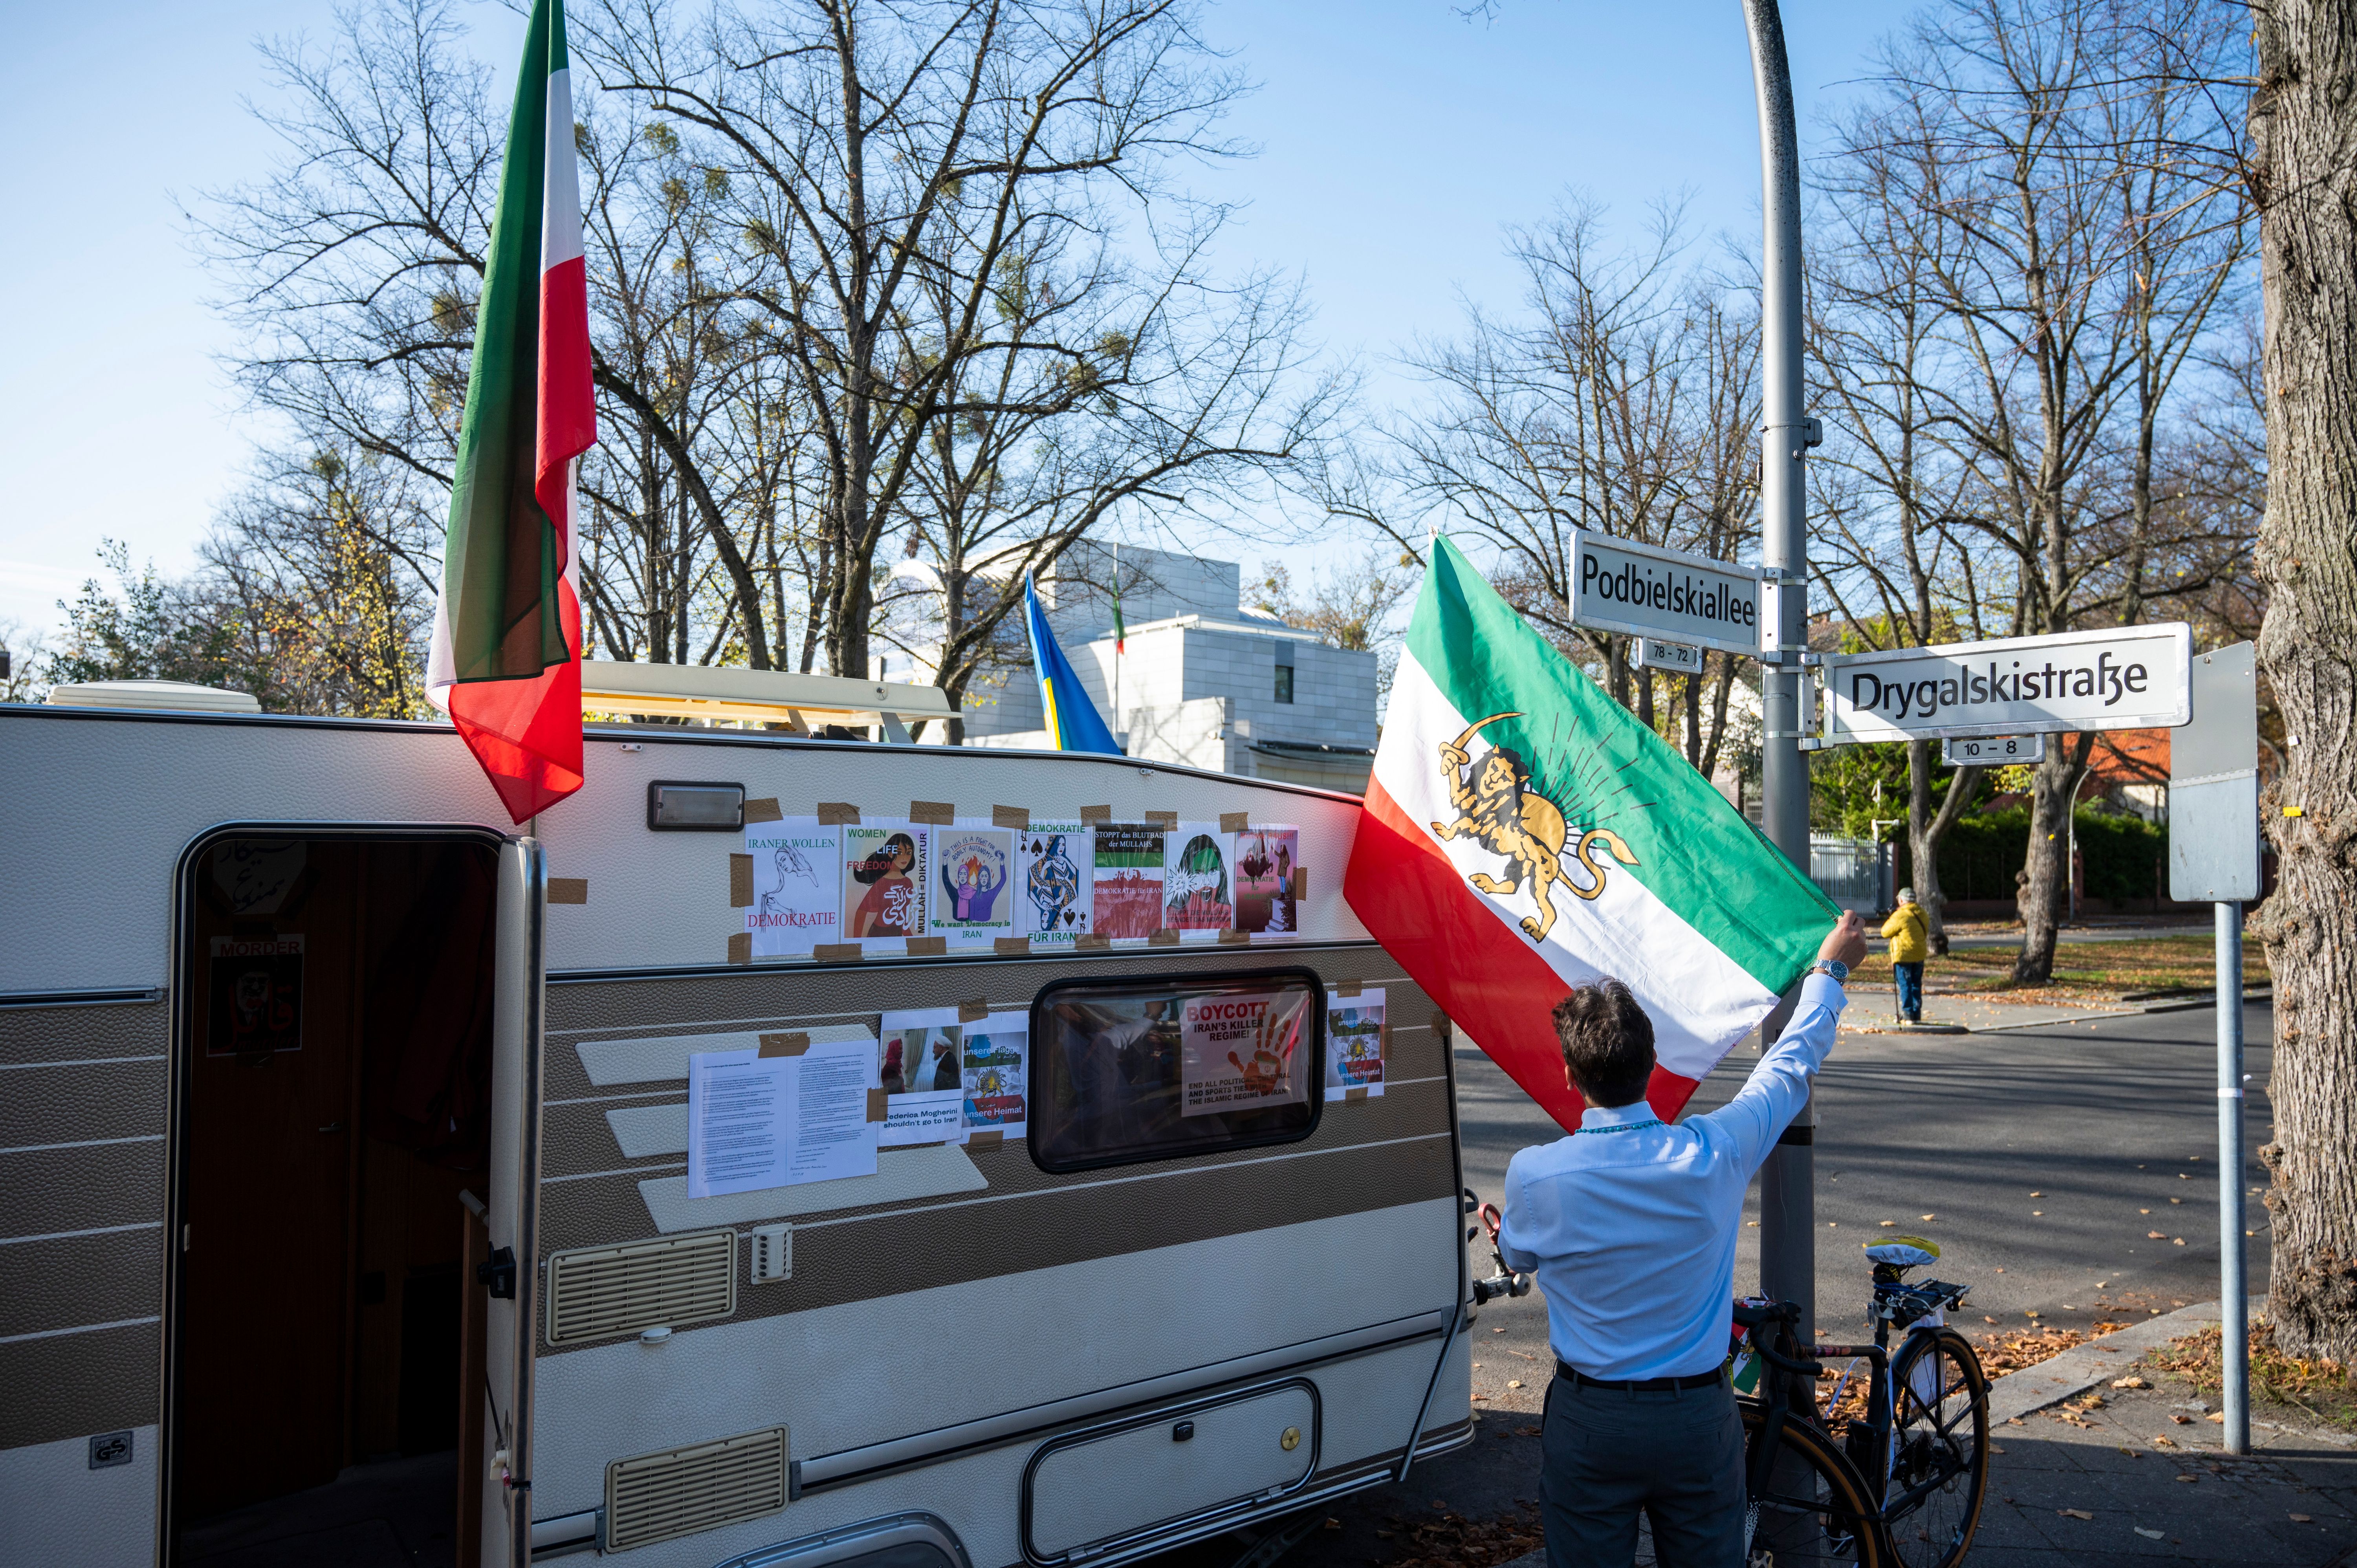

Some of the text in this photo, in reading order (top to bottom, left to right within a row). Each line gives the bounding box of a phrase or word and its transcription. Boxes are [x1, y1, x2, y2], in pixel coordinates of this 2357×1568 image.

[1582, 553, 1754, 626] Podbielskiallee
[1654, 645, 1664, 658] 78
[1677, 648, 1688, 662] 72
[1852, 651, 2148, 719] Drygalskistraße
[1964, 743, 1979, 757] 10
[2006, 740, 2017, 754] 8
[848, 829, 886, 838] WOMEN
[1026, 824, 1085, 833] DEMOKRATIE
[1021, 829, 1027, 842] Q
[748, 839, 835, 848] IRANER WOLLEN
[950, 840, 961, 851] THIS
[976, 837, 988, 846] FIGHT
[876, 845, 898, 854] LIFE
[952, 846, 967, 861] BODILY
[919, 833, 927, 882] DIKTATUR
[847, 861, 895, 870] FREEDOM
[748, 912, 836, 927] DEMOKRATIE
[966, 920, 1003, 928] Democracy
[1079, 923, 1086, 935] Q
[1028, 931, 1076, 942] FÜR IRAN
[1186, 1001, 1269, 1022] BOYCOTT
[1230, 1019, 1263, 1030] KILLER
[1210, 1030, 1249, 1041] REGIME!
[993, 1046, 1019, 1054] Flagge
[1257, 1072, 1290, 1082] CULTURAL
[1205, 1087, 1232, 1096] SPORTS
[1204, 1095, 1232, 1104] ISLAMIC
[1234, 1091, 1259, 1100] REGIME
[921, 1108, 957, 1117] Mogherini
[964, 1105, 1022, 1118] unsere Heimat
[884, 1120, 920, 1128] shouldn't
[97, 1439, 126, 1460] GS
